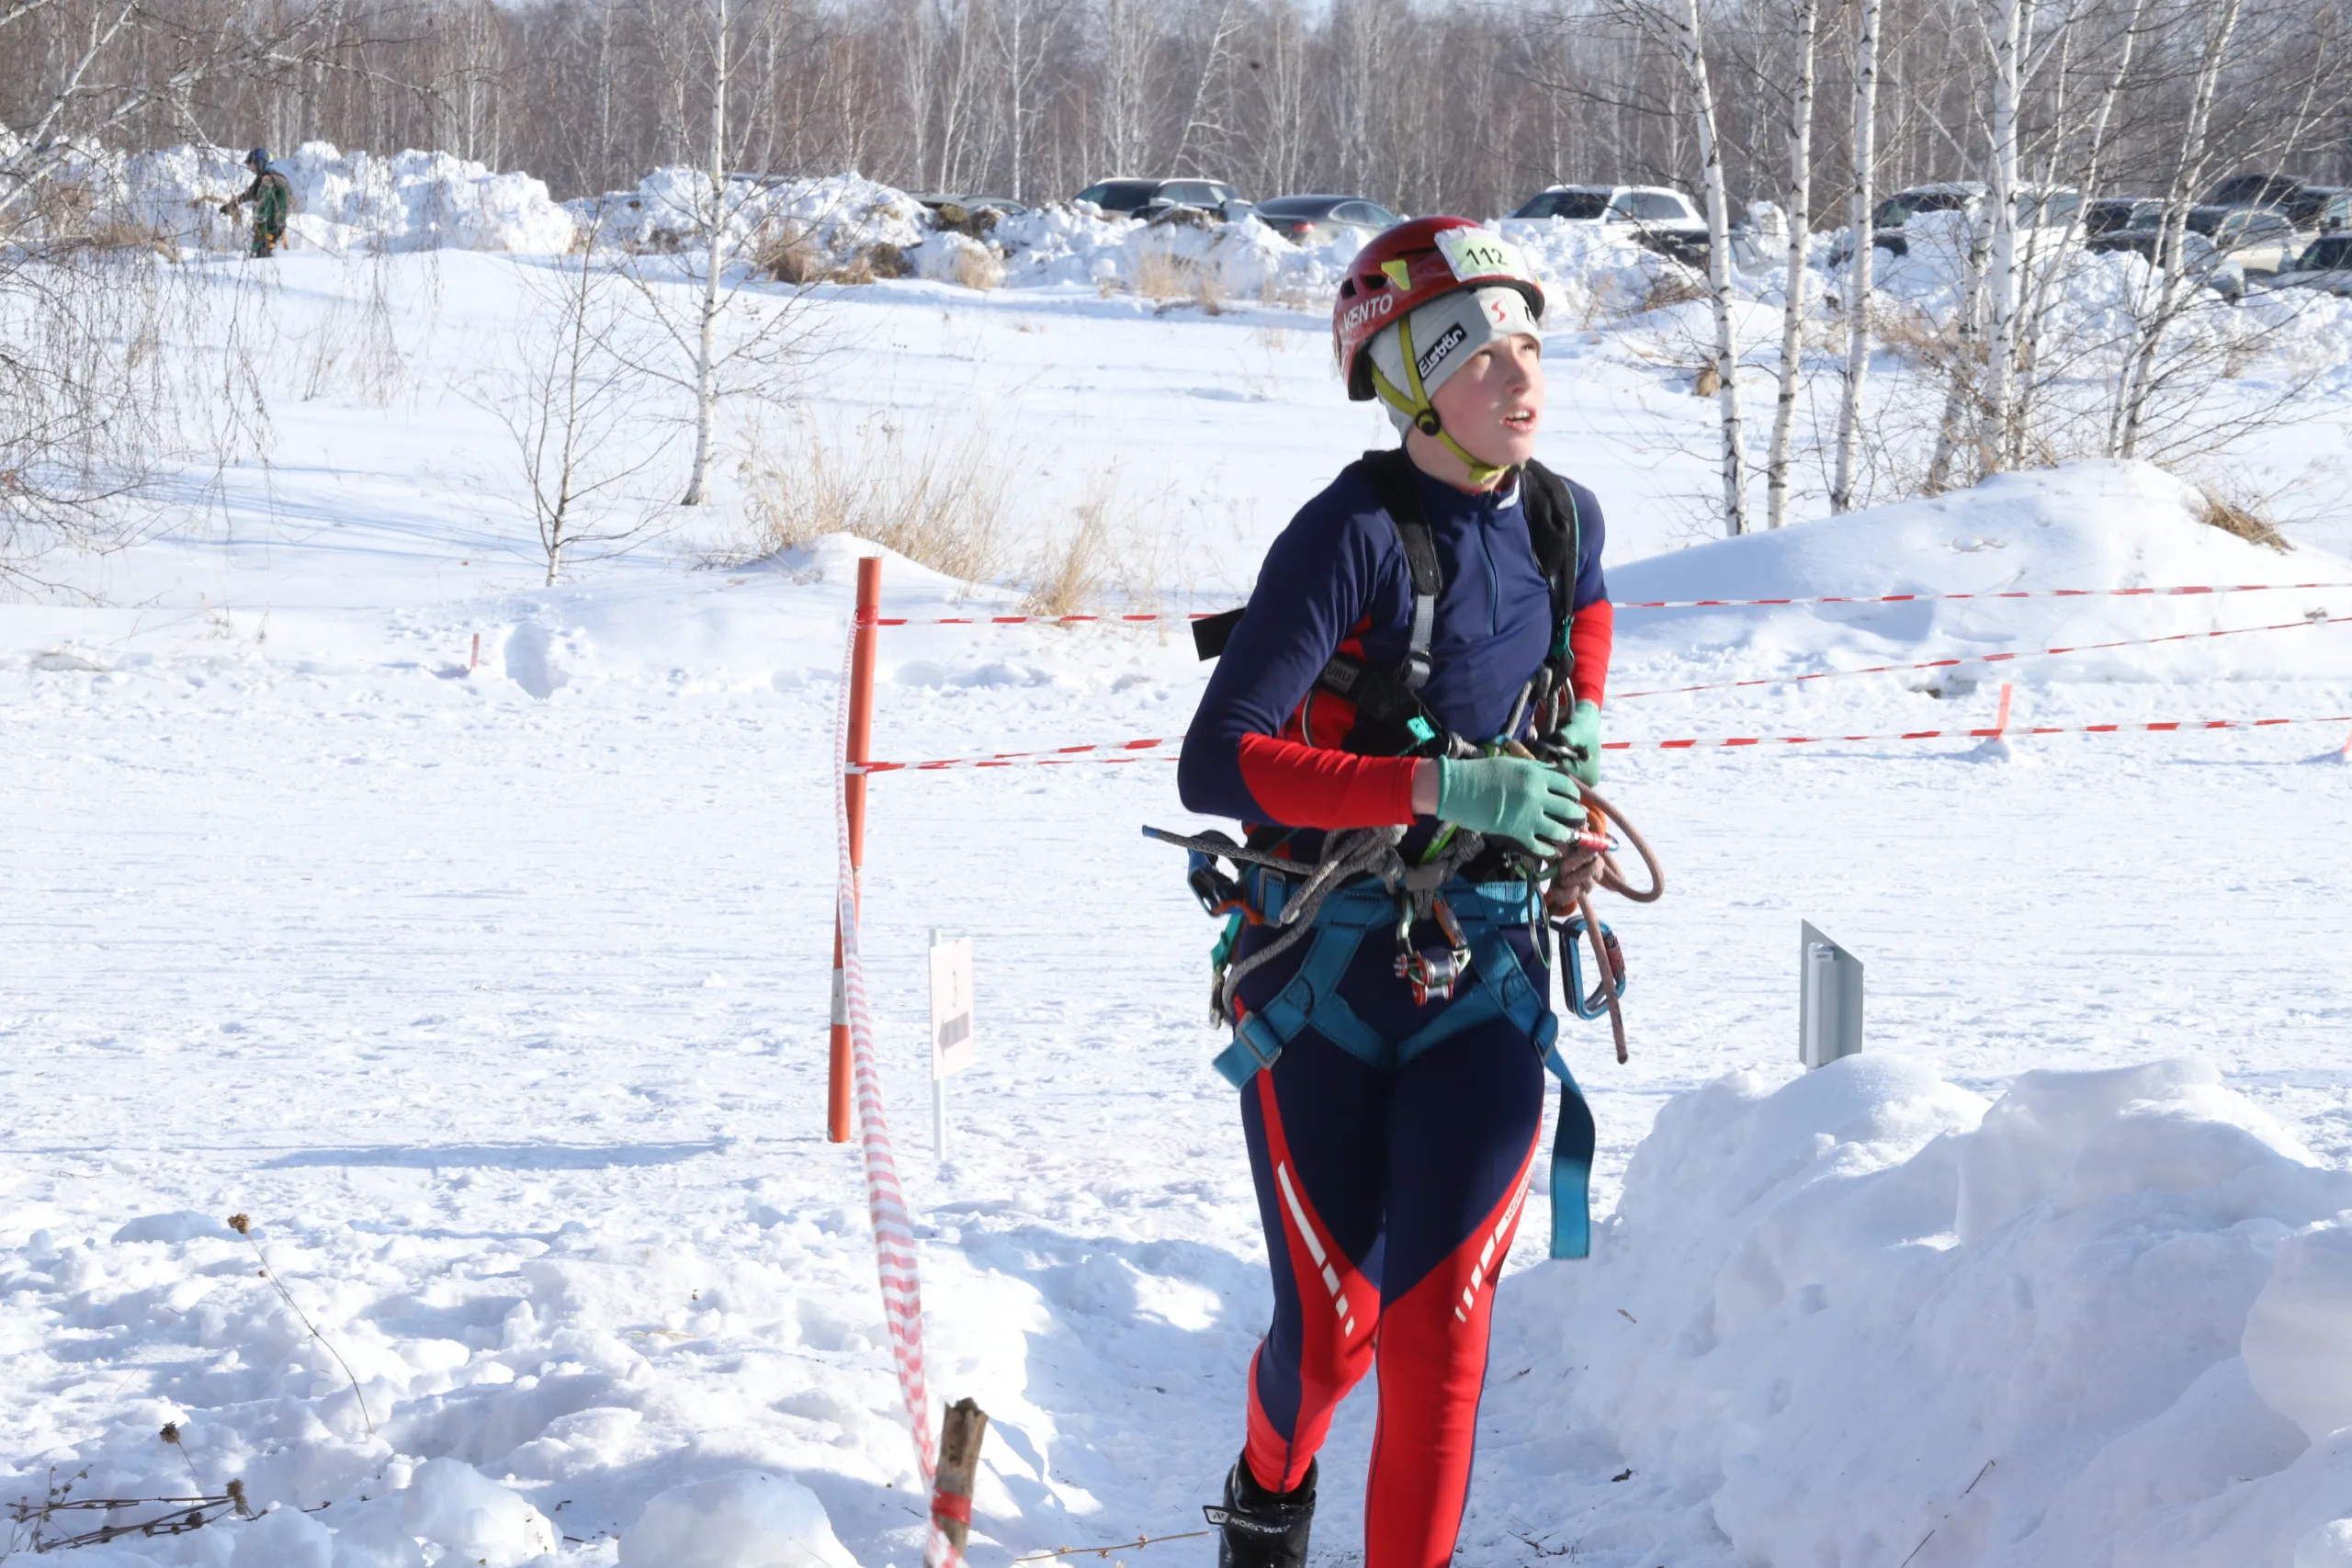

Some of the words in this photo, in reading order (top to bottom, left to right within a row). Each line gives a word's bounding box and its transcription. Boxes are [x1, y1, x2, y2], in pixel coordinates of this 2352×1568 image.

[1466, 247, 1508, 265] 112
[1343, 293, 1393, 331] VENTO
[1419, 330, 1463, 378] Eisbär
